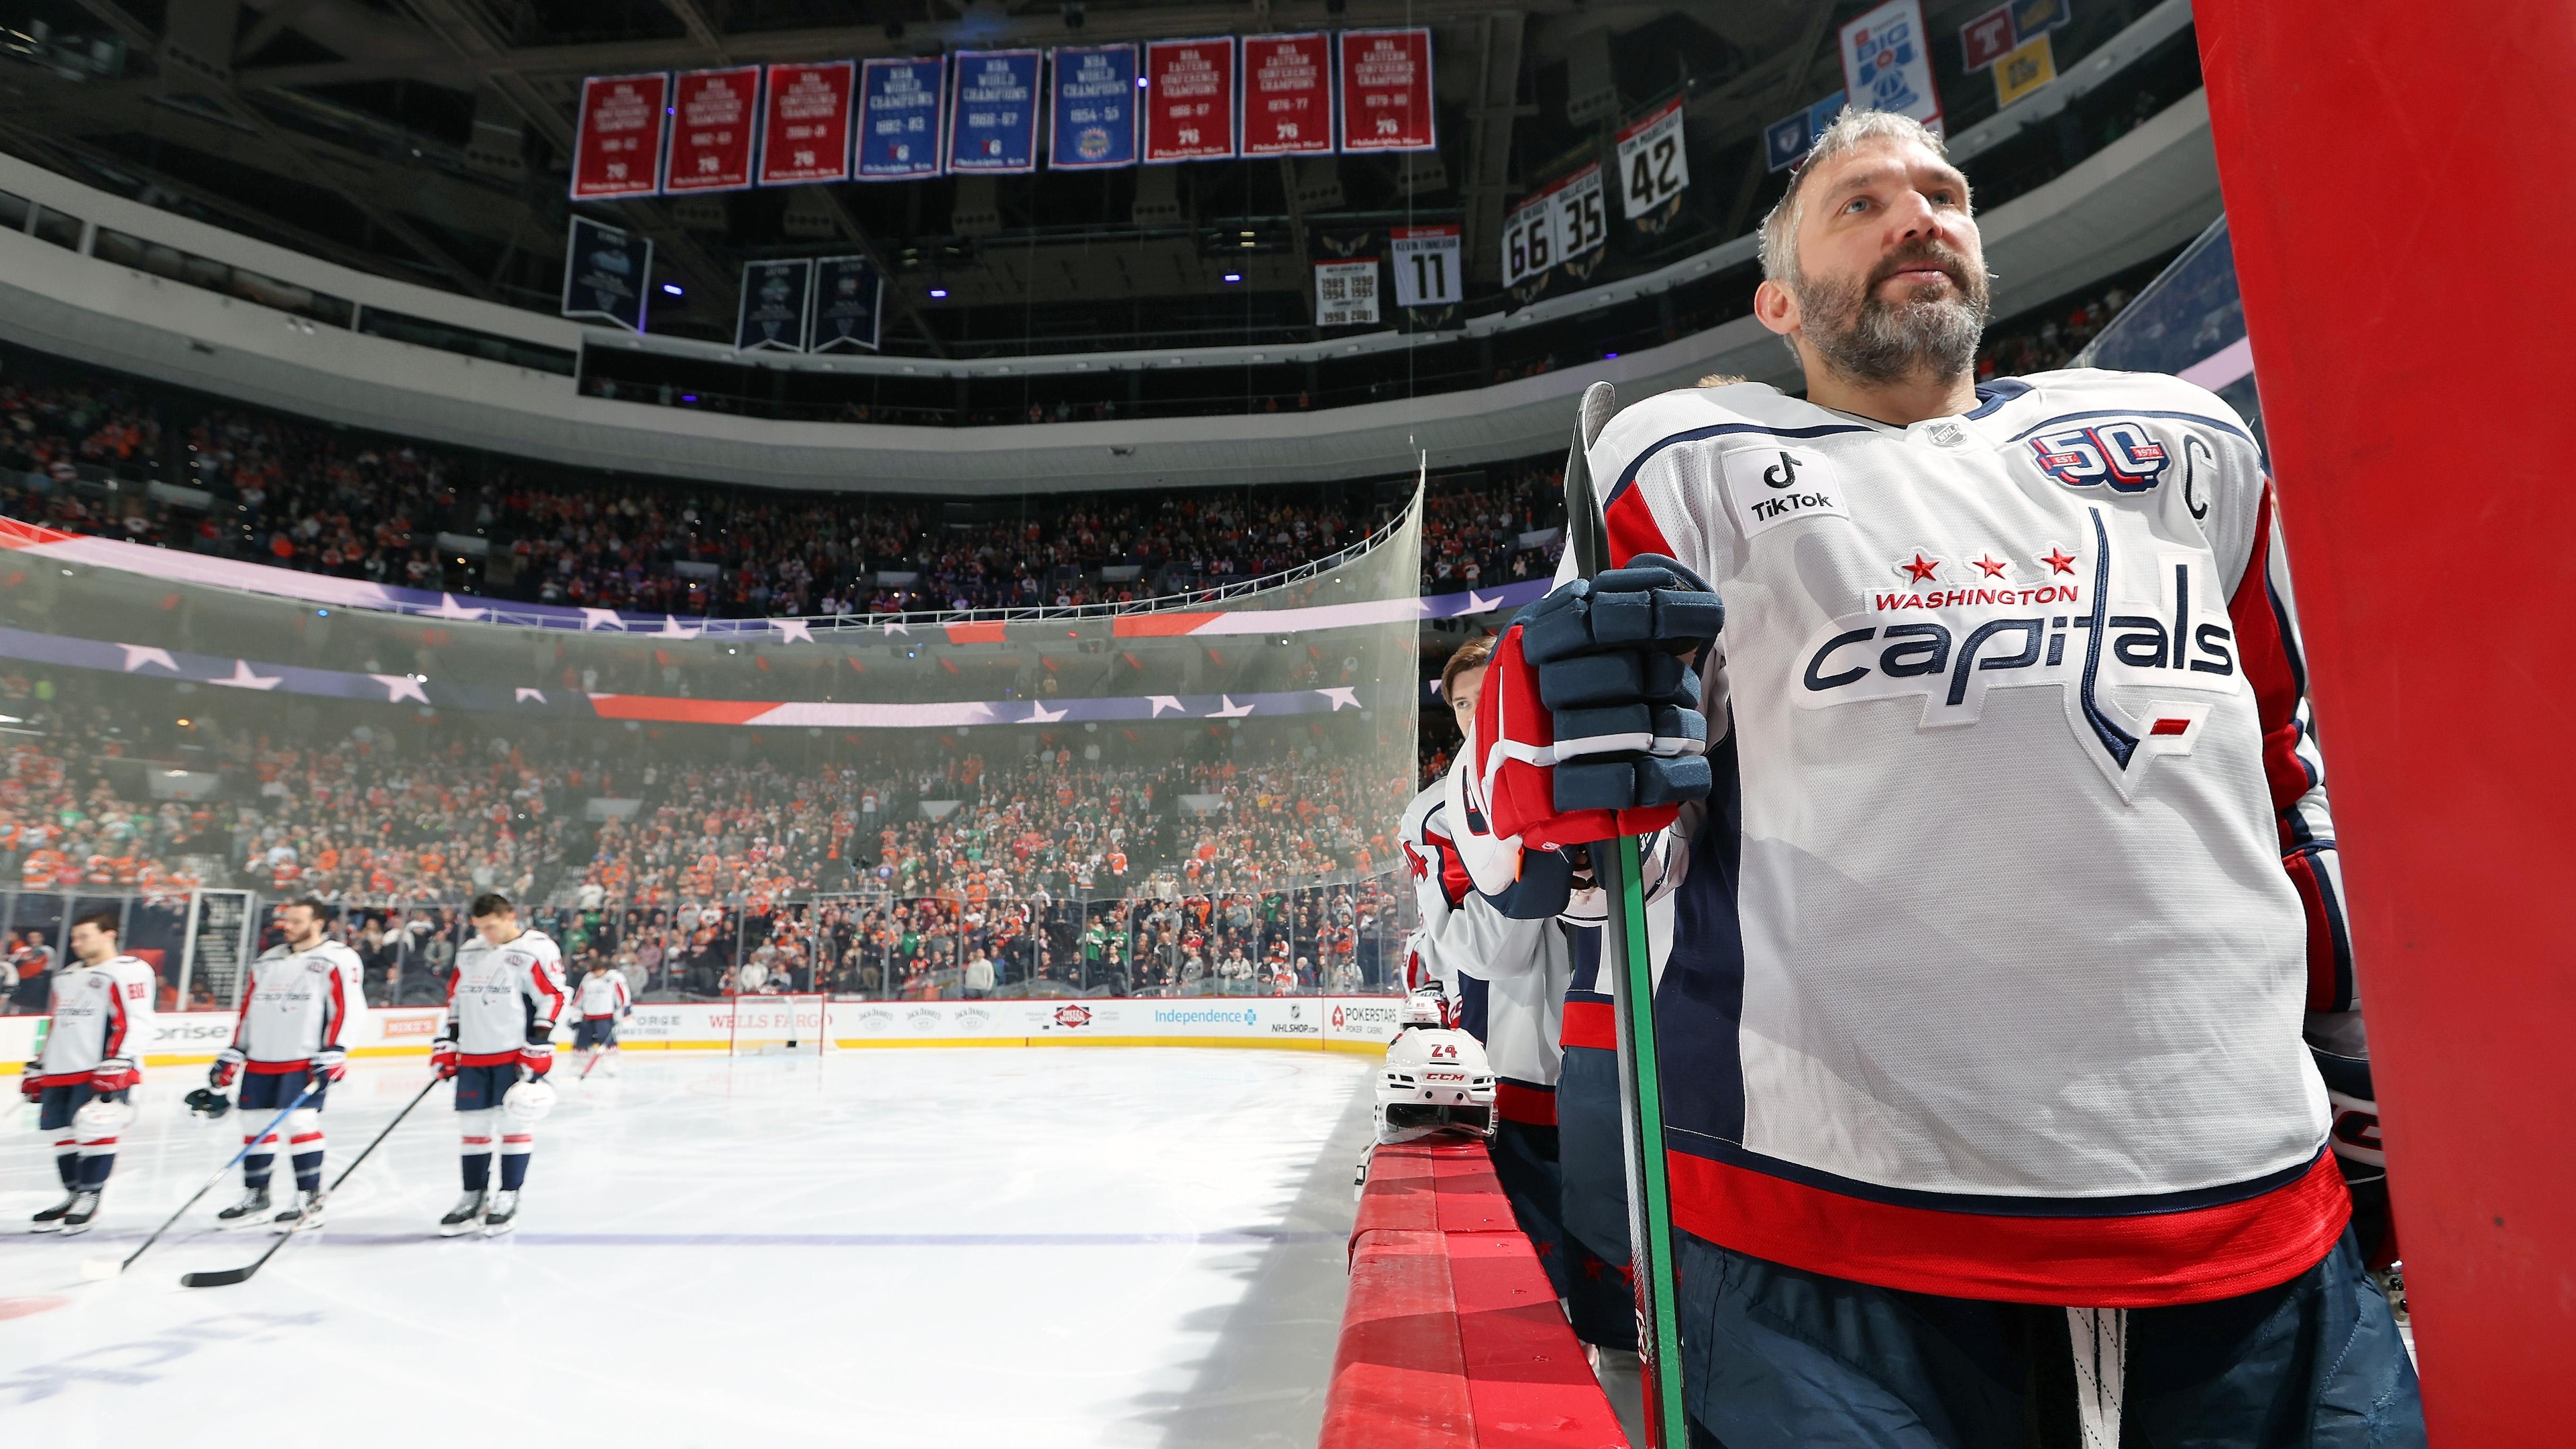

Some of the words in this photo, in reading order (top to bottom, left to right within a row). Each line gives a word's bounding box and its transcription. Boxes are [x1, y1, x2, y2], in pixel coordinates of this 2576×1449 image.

[1973, 17, 2004, 56] T
[1277, 123, 1298, 140] 76
[1377, 119, 1398, 135] 76
[980, 140, 1002, 156] 76
[1631, 135, 1679, 205] 42
[1565, 189, 1602, 253] 35
[1509, 217, 1548, 279] 66
[1411, 253, 1444, 299] 11
[1937, 425, 1956, 443] NHL
[2041, 423, 2160, 478] 50
[2136, 447, 2159, 458] 1974
[2184, 434, 2212, 520] C
[1751, 492, 1833, 522] TikTok
[1876, 585, 2079, 610] WASHINGTON
[709, 1014, 769, 1029] WELLS
[1155, 1009, 1242, 1025] Independence
[1346, 1008, 1397, 1023] POKERSTARS
[1431, 1044, 1458, 1059] 24
[1426, 1073, 1465, 1081] CCM
